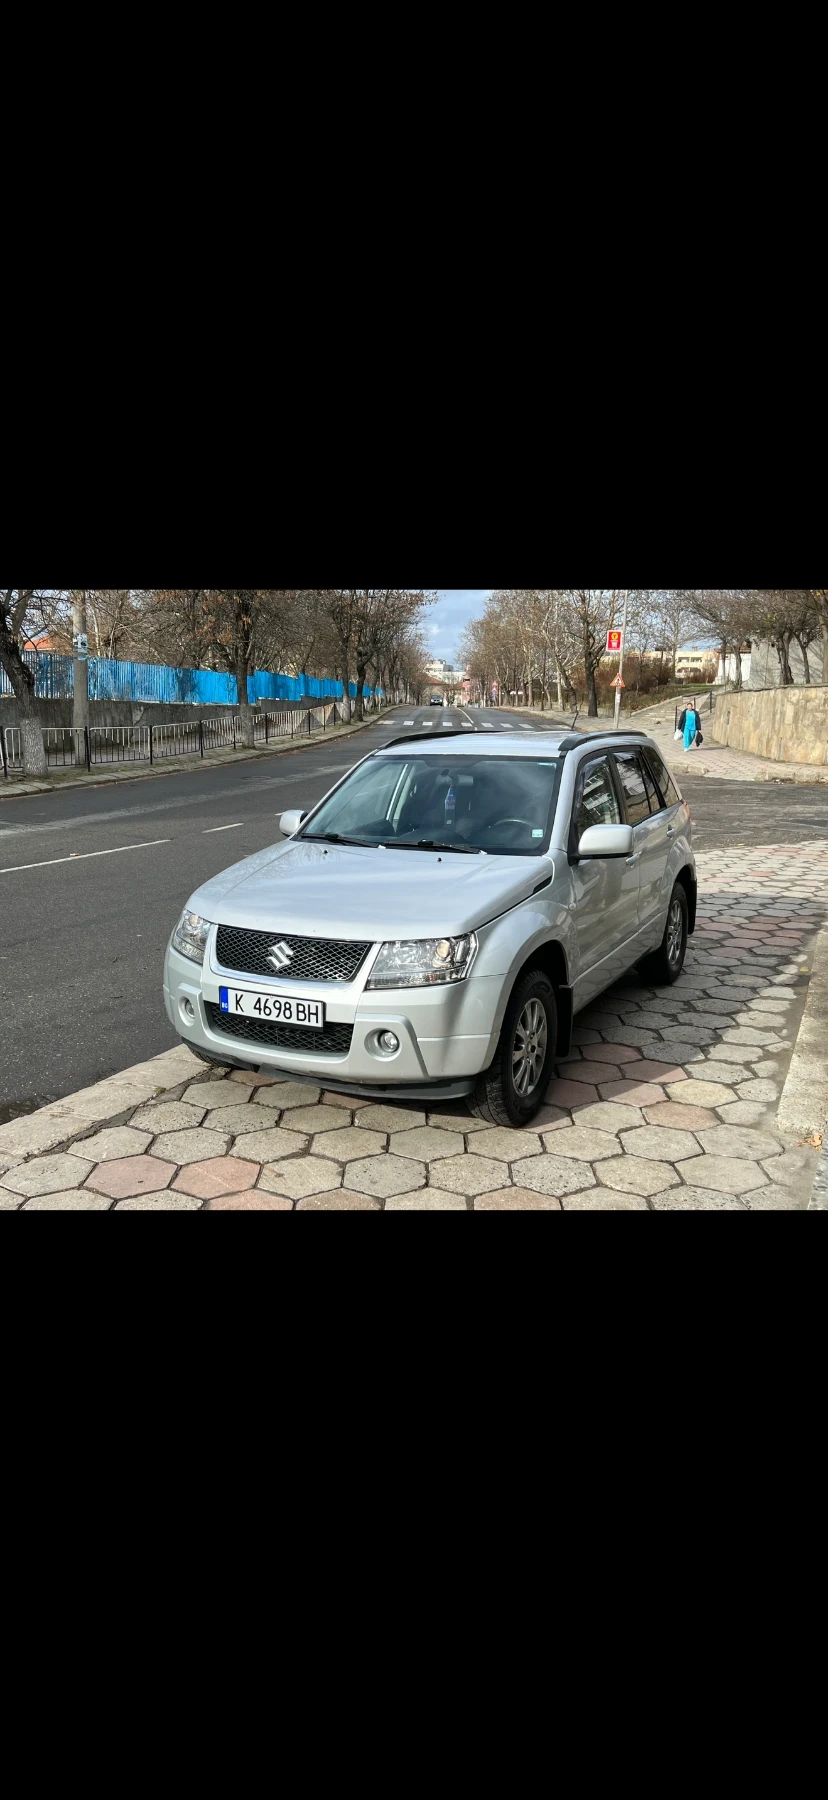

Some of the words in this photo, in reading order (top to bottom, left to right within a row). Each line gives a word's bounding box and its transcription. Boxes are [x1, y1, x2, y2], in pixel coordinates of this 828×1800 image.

[235, 993, 244, 1012] K
[253, 997, 292, 1020] 4698
[296, 1002, 319, 1024] BH
